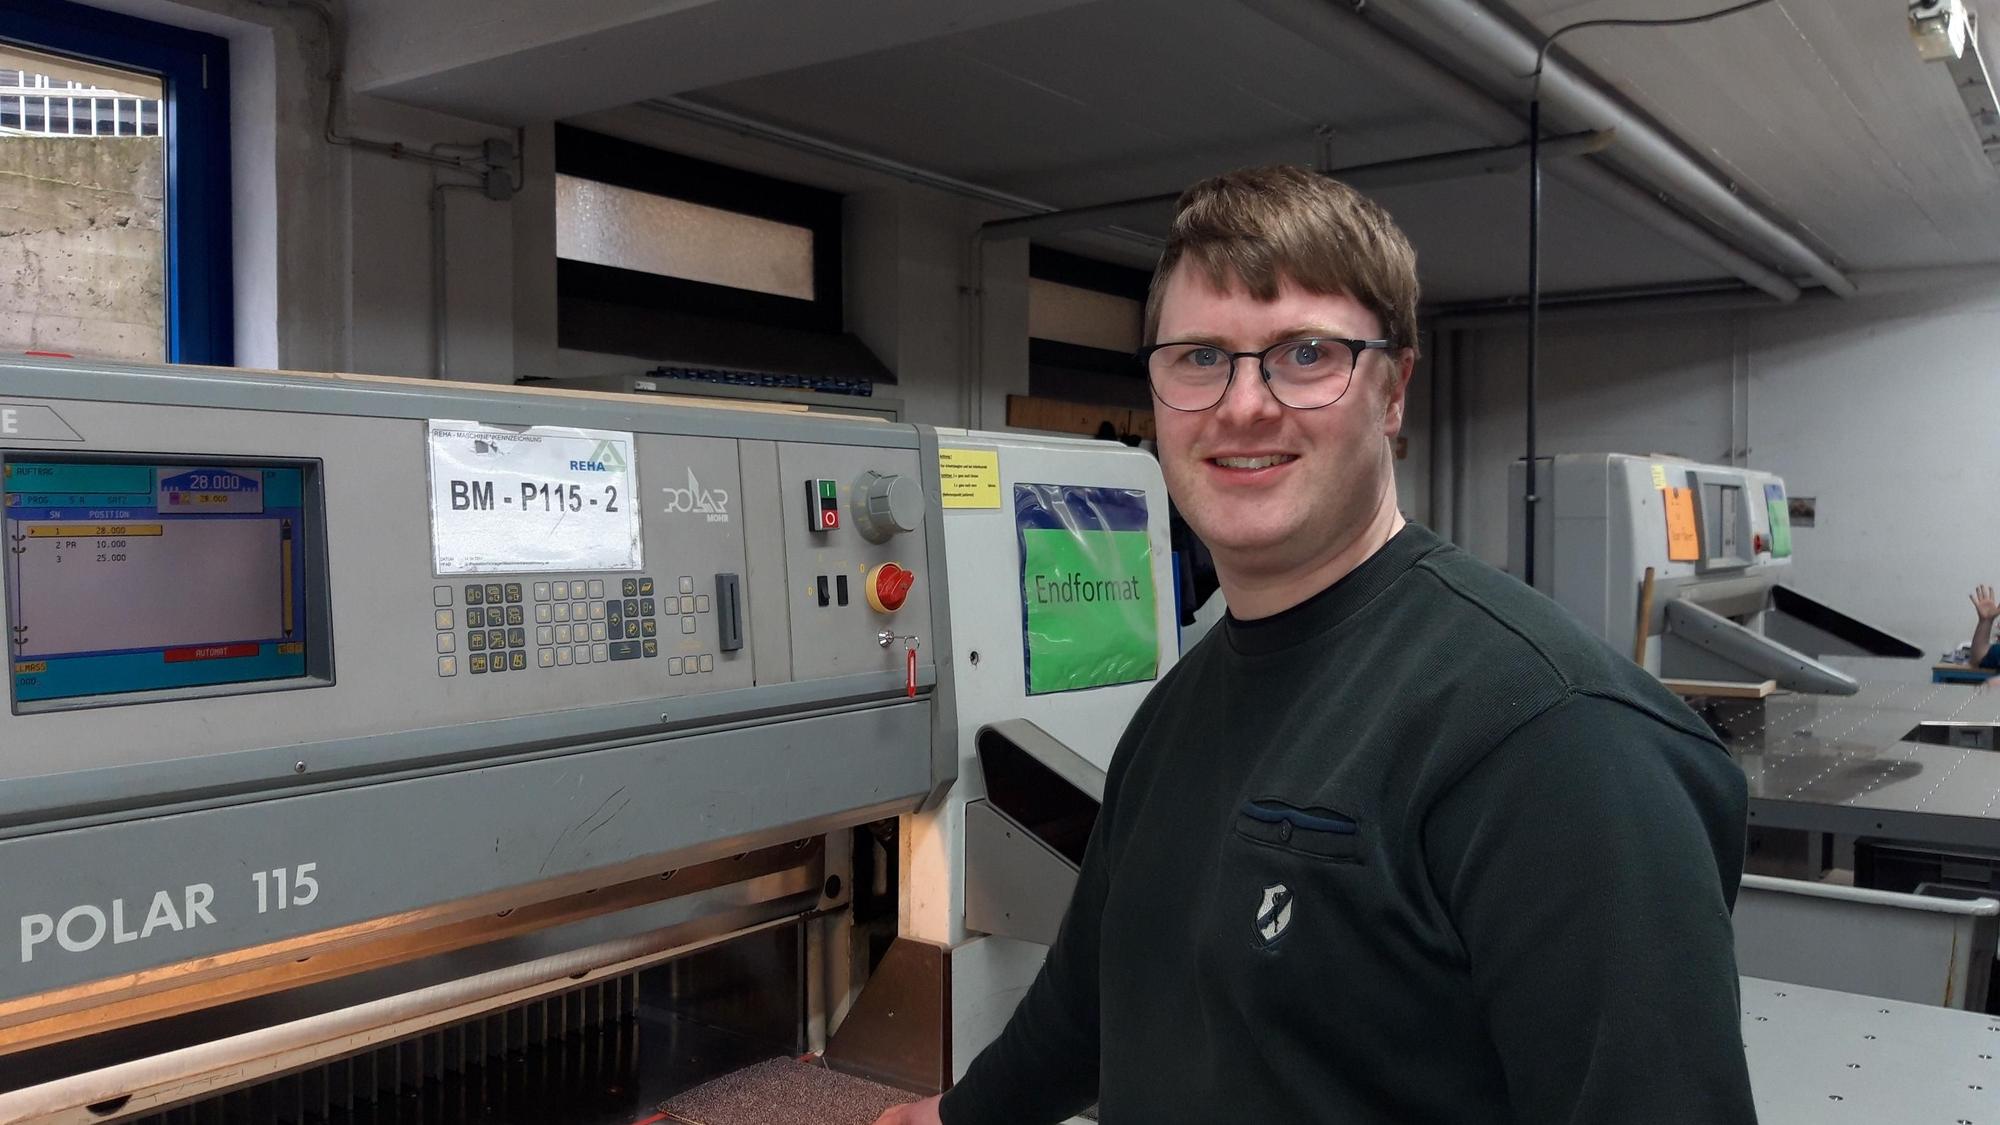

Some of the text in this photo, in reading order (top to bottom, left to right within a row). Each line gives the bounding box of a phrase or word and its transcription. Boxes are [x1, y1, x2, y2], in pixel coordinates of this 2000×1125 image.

[2, 409, 18, 434] E
[433, 430, 452, 438] REHA
[570, 460, 606, 472] REHA
[16, 467, 54, 476] AUFTRAG
[190, 475, 239, 490] 28.000
[450, 480, 494, 511] BM
[521, 482, 583, 513] P115
[604, 485, 619, 513] 2
[50, 510, 130, 519] SN POSITION
[707, 513, 729, 523] MOHR
[96, 526, 126, 535] 28.000
[55, 541, 61, 549] 2
[96, 540, 126, 549] 10.000
[96, 553, 127, 562] 25.000
[1035, 572, 1141, 604] Endformat
[195, 647, 228, 657] AUTOMAT
[21, 862, 319, 963] POLAR 115
